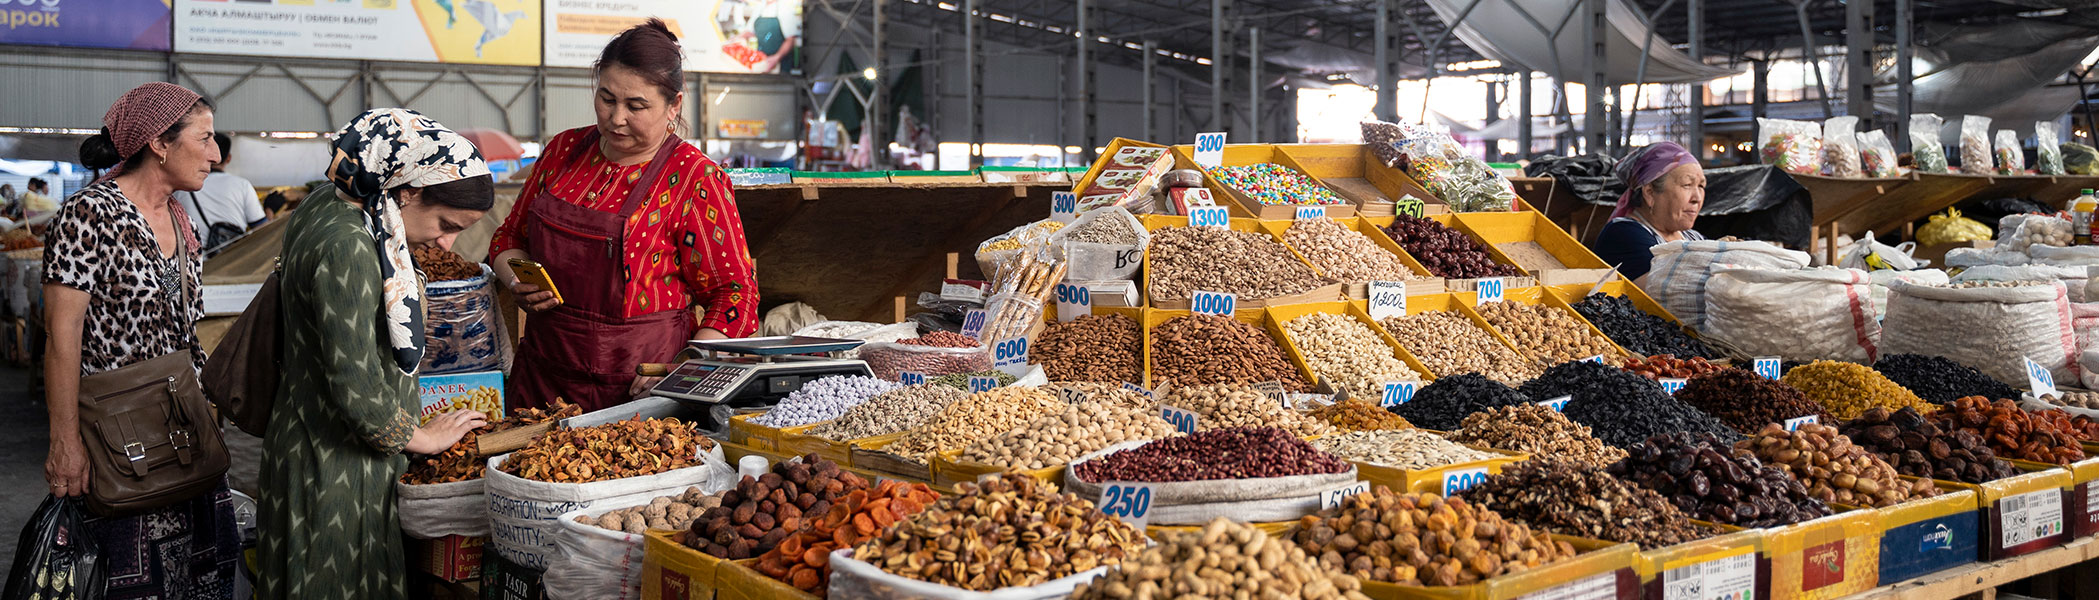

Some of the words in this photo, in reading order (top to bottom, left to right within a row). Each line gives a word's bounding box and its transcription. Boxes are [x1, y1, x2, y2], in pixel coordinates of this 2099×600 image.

[1197, 134, 1223, 152] 300
[1054, 194, 1075, 213] 300
[1190, 209, 1228, 226] 1300
[1057, 284, 1089, 306] 900
[1479, 280, 1501, 298] 700
[1194, 293, 1233, 315] 1000
[964, 311, 986, 332] 180
[996, 337, 1027, 360] 600
[1757, 360, 1779, 380] 350
[2028, 360, 2053, 388] 180
[971, 377, 997, 394] 250
[1384, 383, 1414, 405] 700
[1446, 471, 1486, 497] 600
[1102, 485, 1151, 518] 250
[505, 572, 528, 598] YASIR
